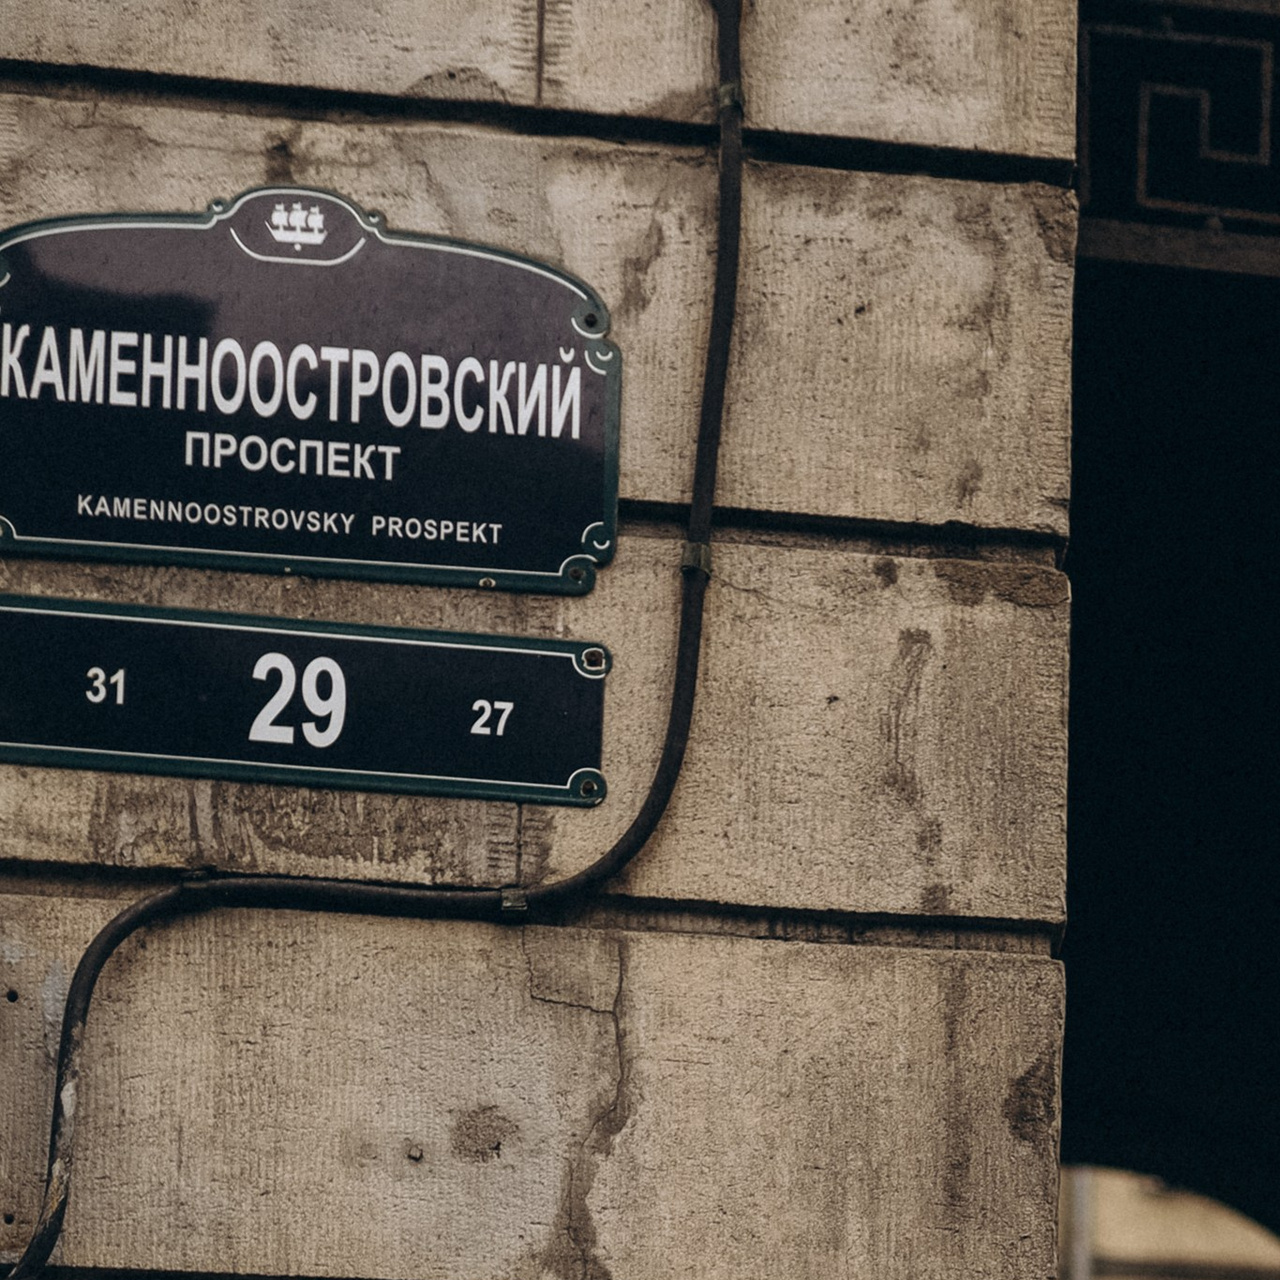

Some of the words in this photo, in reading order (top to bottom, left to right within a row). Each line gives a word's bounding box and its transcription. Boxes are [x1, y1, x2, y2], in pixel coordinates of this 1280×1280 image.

[0, 322, 582, 440] КАМЕННООСТРОВСКИЙ
[185, 431, 401, 481] ПРОСПЕКТ
[77, 494, 355, 534] KAMENNOOSTROVSKY
[372, 515, 503, 544] PROSPEKT
[85, 667, 126, 705] 31
[248, 652, 347, 748] 29
[470, 699, 515, 737] 27
